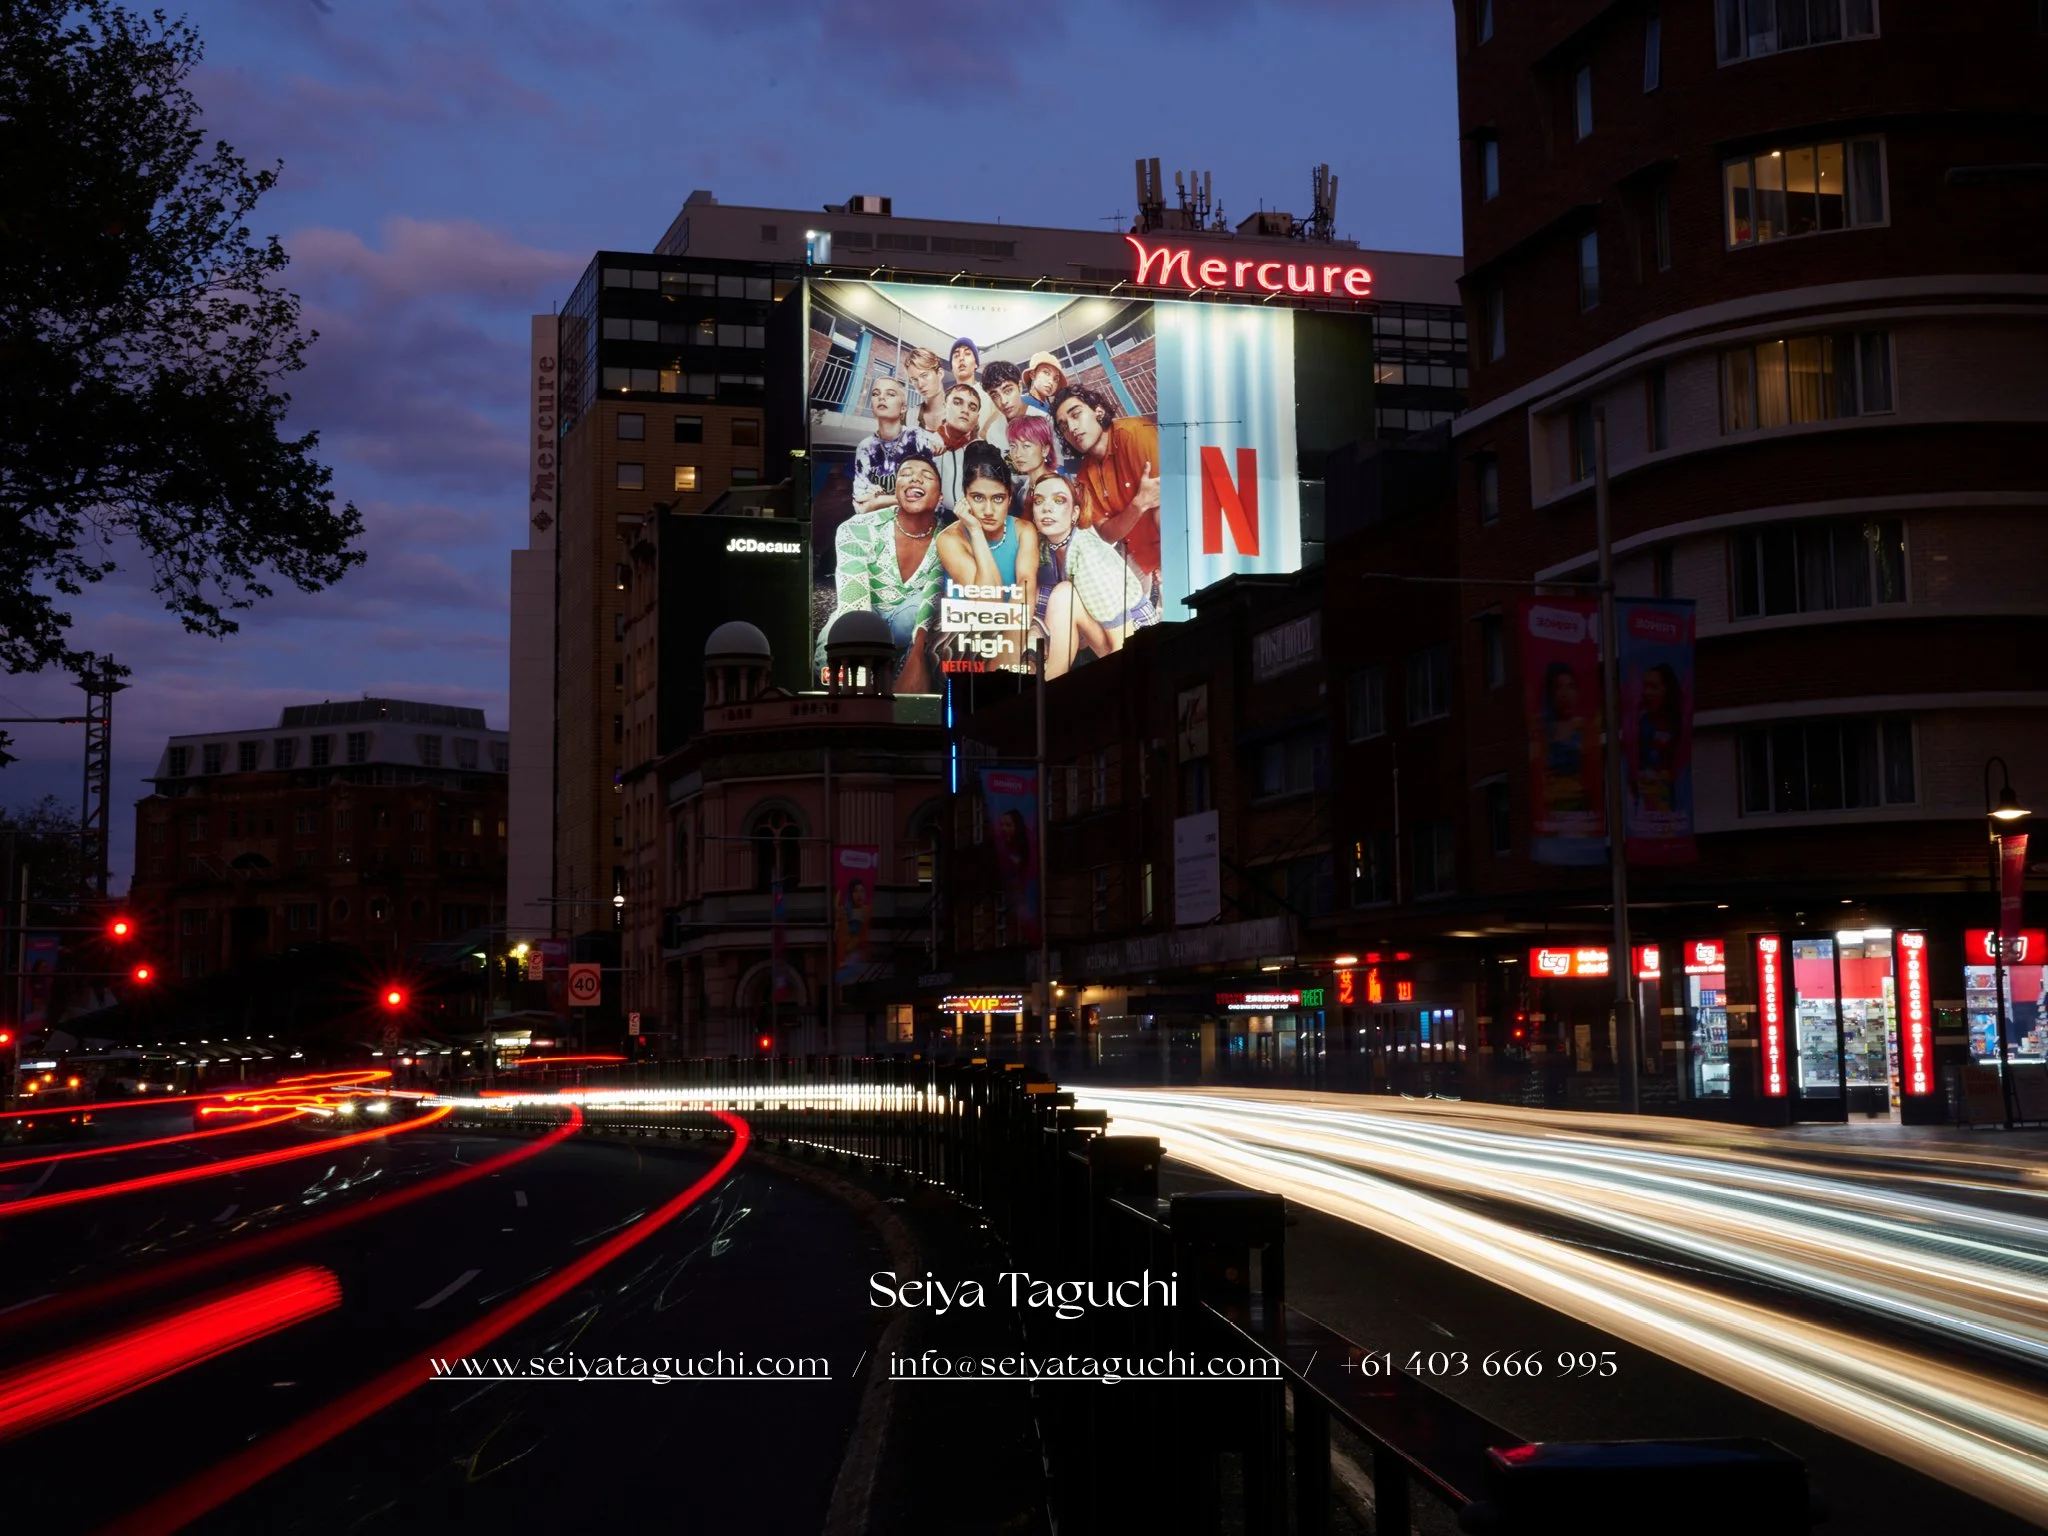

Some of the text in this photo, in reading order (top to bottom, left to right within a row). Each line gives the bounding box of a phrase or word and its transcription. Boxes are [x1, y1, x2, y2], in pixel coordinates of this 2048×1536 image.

[1125, 236, 1372, 296] Mercure
[531, 355, 555, 503] Mercure
[726, 538, 801, 553] JCDecaux
[946, 578, 1023, 600] heart
[946, 605, 1024, 625] break
[958, 633, 1014, 659] high
[941, 660, 985, 673] NETFLIX
[1538, 950, 1570, 975] tsg
[1695, 943, 1716, 965] tsg
[574, 977, 595, 992] 40
[968, 998, 1000, 1011] VIP
[1764, 954, 1781, 1094] TOBACCO STATION
[1906, 950, 1927, 1093] TOBACCO STATION
